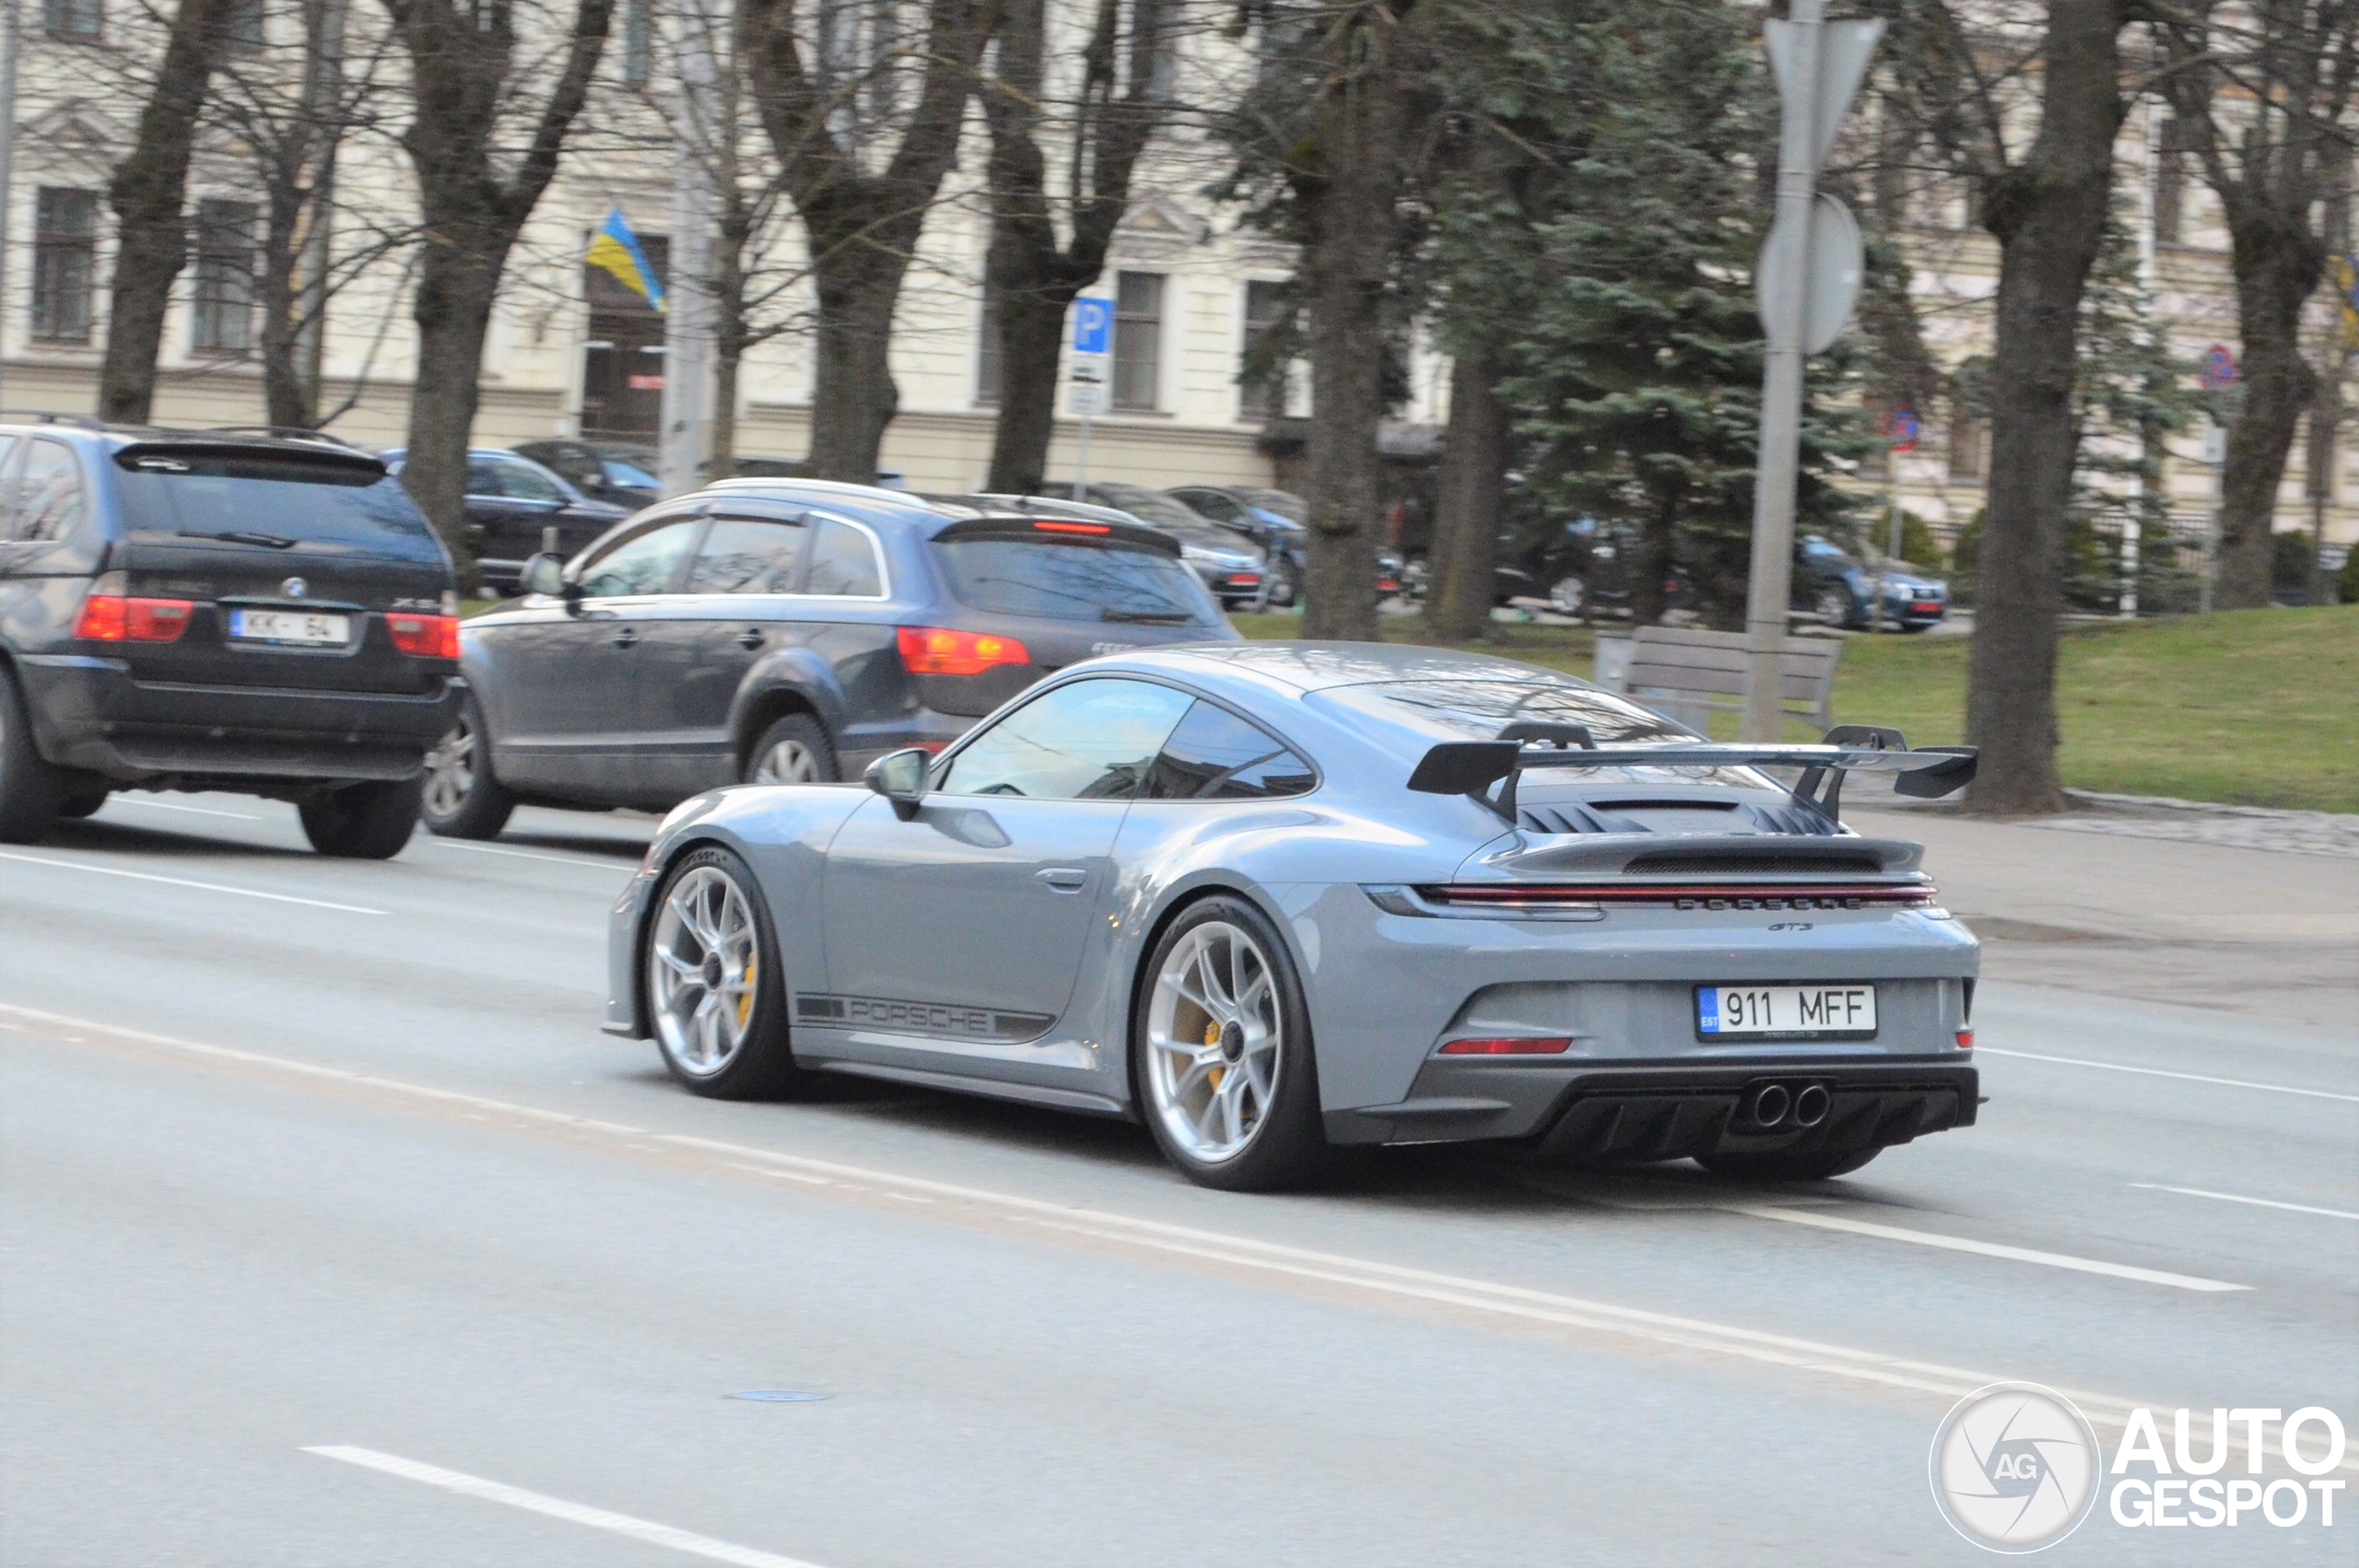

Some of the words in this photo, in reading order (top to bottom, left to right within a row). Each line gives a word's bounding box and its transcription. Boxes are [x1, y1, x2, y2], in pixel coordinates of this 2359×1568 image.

[1077, 303, 1105, 345] P
[1674, 897, 1862, 910] PORSCHE
[1767, 922, 1814, 931] GT3
[851, 1000, 988, 1031] PORSCHE
[1727, 991, 1772, 1026] 911
[1799, 990, 1865, 1025] MFF
[1701, 1016, 1719, 1027] EST
